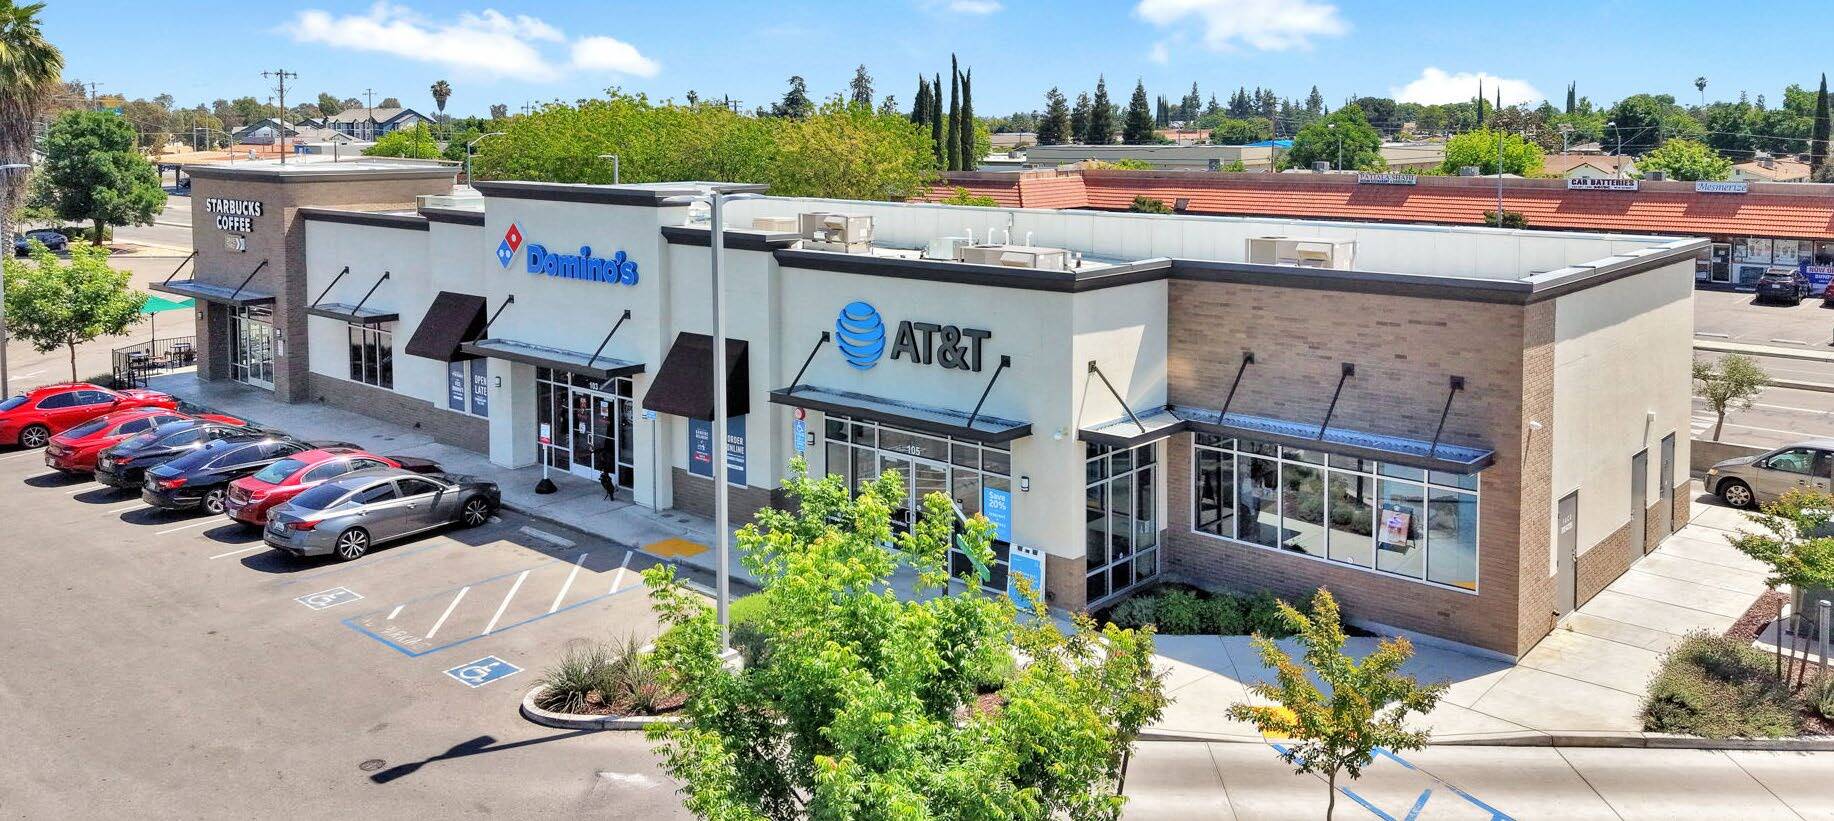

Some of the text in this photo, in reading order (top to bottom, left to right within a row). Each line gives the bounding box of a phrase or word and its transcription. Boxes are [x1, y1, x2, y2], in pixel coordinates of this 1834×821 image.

[1590, 179, 1635, 187] BATTERIES
[1698, 182, 1747, 192] Mesmerize
[206, 198, 263, 217] STARBUCKS
[216, 215, 253, 233] COFFEE
[527, 244, 640, 286] Domino's
[890, 320, 992, 373] AT&T
[474, 374, 487, 386] OPEN
[474, 384, 487, 396] LATE
[589, 382, 599, 391] 103
[727, 434, 744, 446] ORDER
[908, 444, 921, 456] 105
[988, 491, 1006, 502] Save
[989, 500, 1007, 511] 20%
